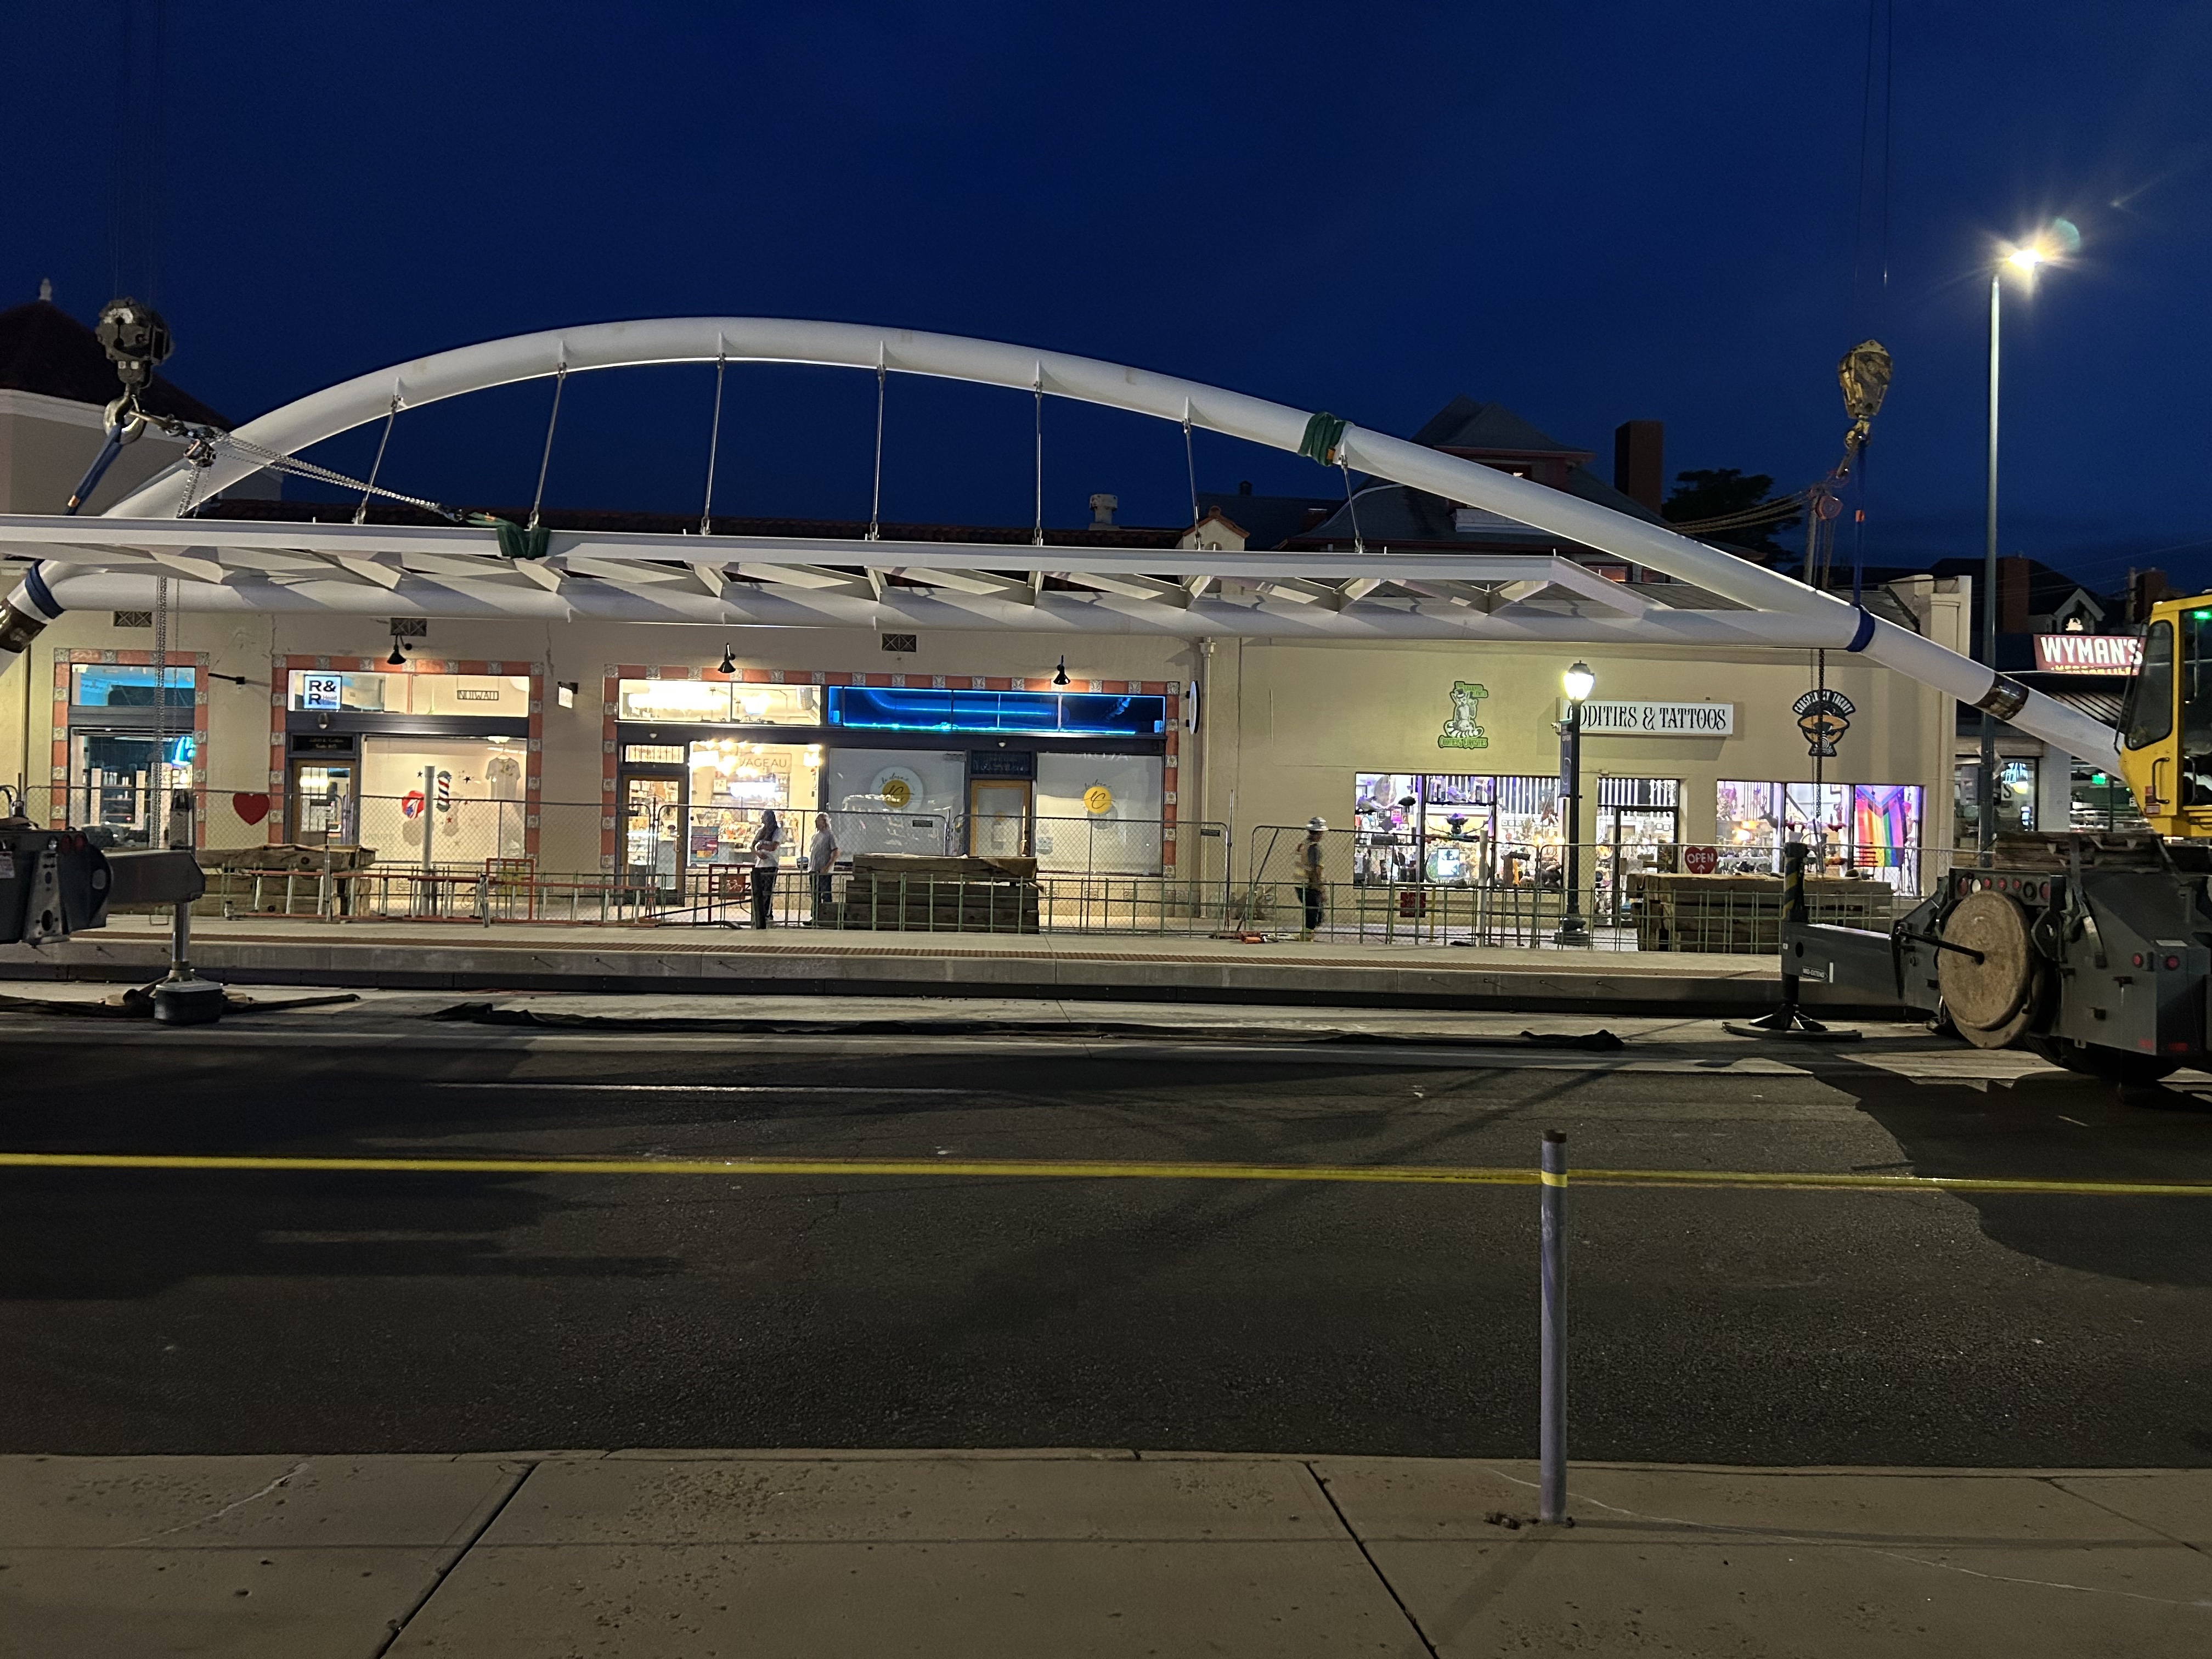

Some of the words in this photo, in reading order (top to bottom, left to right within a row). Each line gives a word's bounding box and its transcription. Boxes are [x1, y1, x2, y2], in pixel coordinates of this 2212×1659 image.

[2040, 636, 2143, 665] WYMAN'S
[308, 680, 336, 692] R&
[1794, 691, 1831, 713] CONSPIRCY
[1832, 693, 1854, 713] THEORY
[1643, 707, 1655, 730] &
[1660, 707, 1726, 730] TATTOOS
[1687, 853, 1714, 864] OPEN
